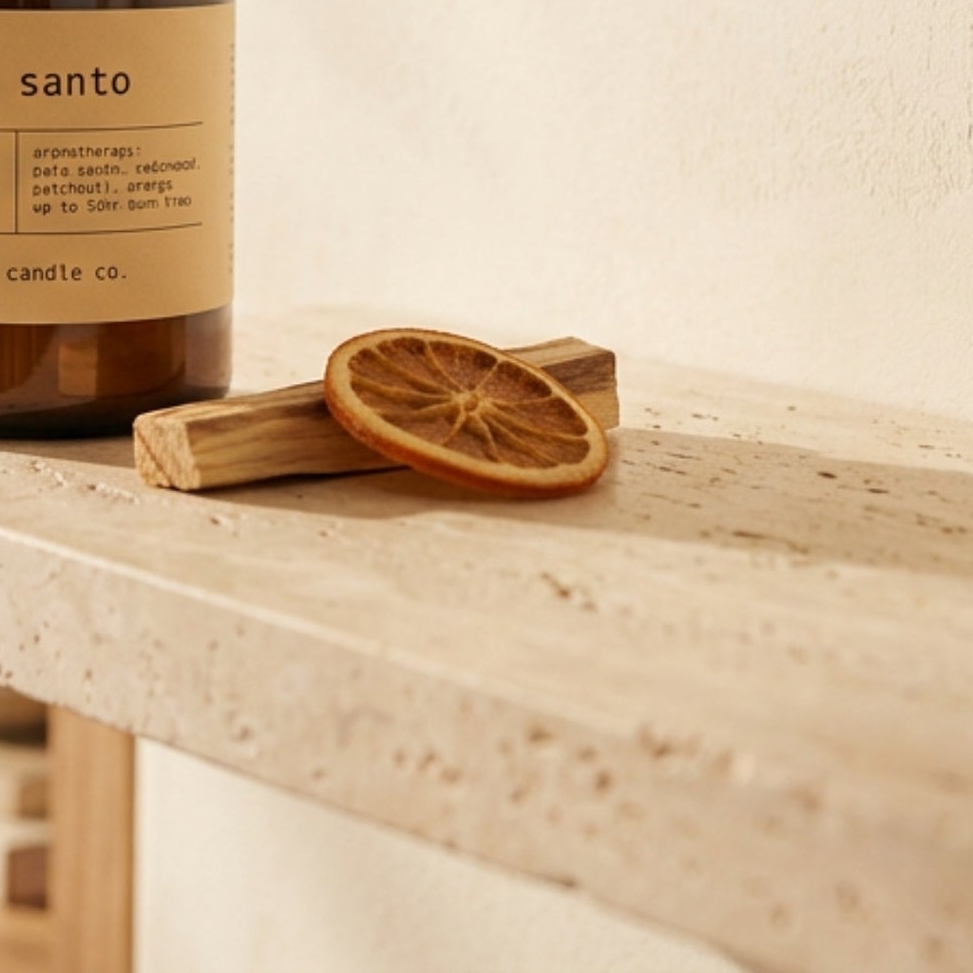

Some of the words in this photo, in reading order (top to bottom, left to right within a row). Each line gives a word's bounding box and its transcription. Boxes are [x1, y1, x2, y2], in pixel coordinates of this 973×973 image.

[20, 67, 131, 97] santo
[32, 203, 51, 216] up
[61, 201, 78, 214] to
[6, 263, 83, 282] candle
[95, 265, 127, 281] co.
